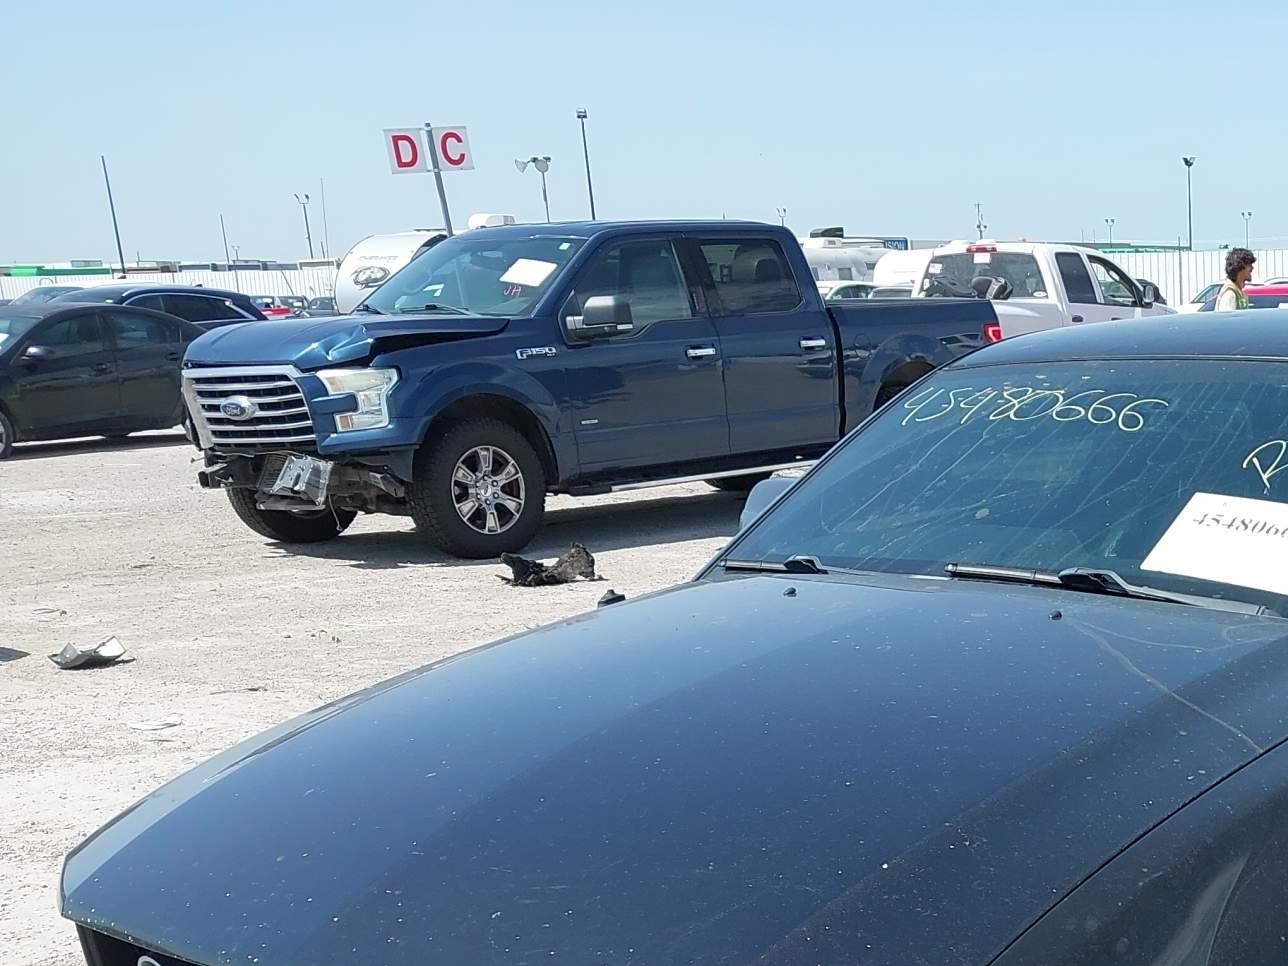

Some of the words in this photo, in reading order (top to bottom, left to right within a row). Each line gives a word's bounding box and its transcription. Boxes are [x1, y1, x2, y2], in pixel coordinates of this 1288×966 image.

[391, 134, 418, 168] D
[440, 131, 466, 166] C
[902, 387, 1169, 432] 45480666
